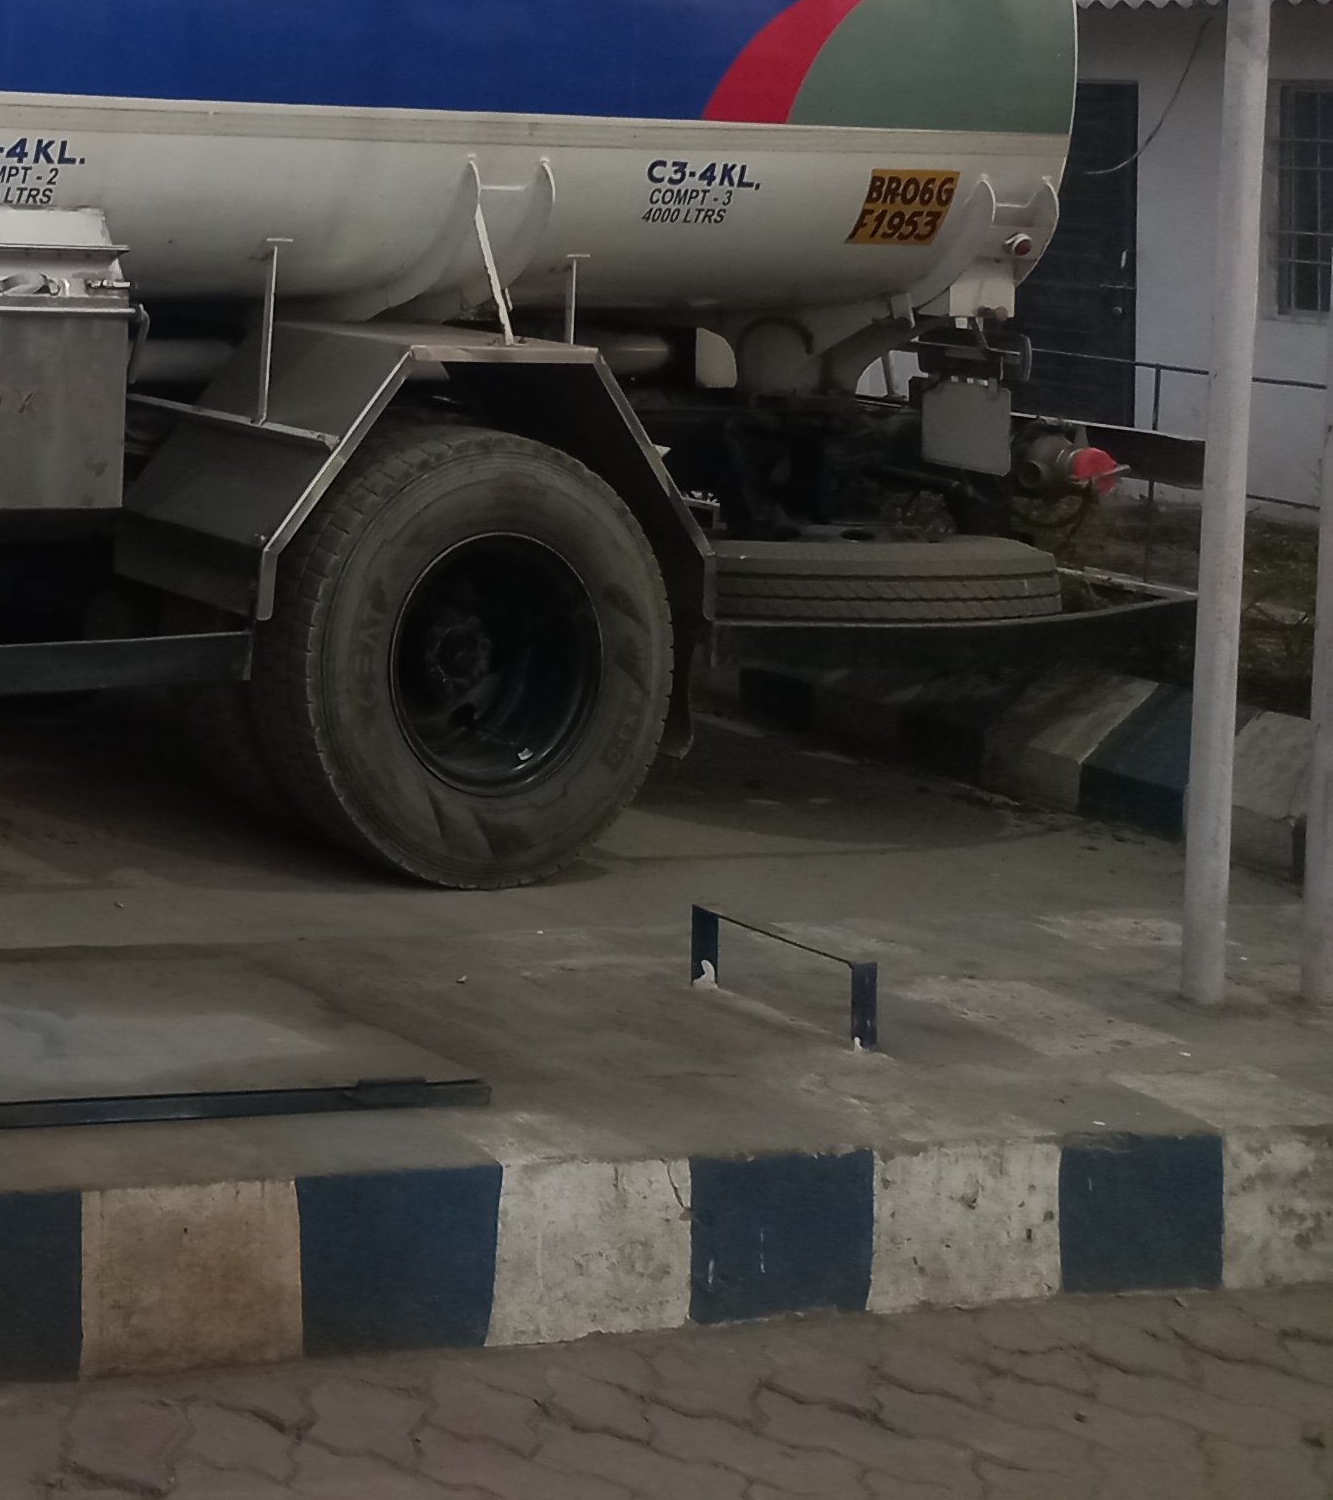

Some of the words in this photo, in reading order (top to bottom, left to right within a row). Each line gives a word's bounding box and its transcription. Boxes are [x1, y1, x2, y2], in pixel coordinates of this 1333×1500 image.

[46, 167, 59, 186] 2
[4, 186, 53, 204] LTRS
[649, 188, 710, 206] COMPT
[722, 189, 733, 207] 3
[641, 207, 680, 223] 4000
[683, 208, 727, 224] LTRS
